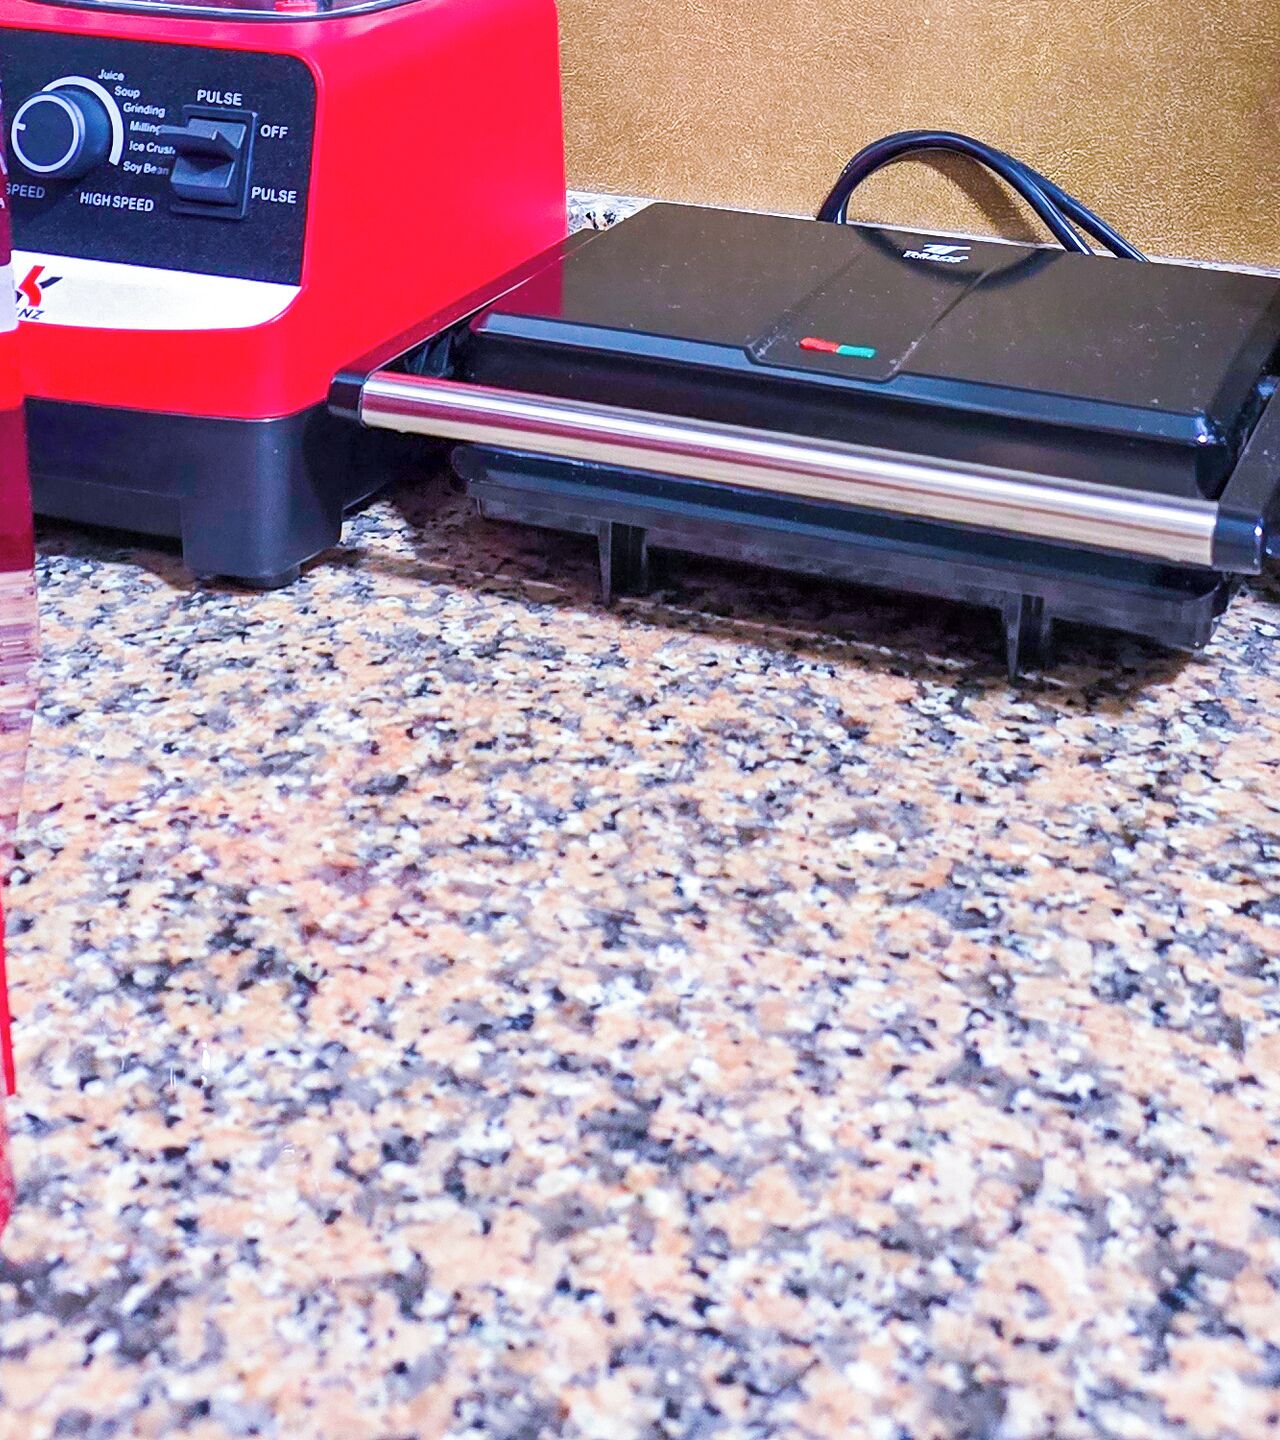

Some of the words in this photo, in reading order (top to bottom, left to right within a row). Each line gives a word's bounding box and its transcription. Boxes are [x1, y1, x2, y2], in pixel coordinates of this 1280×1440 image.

[98, 69, 125, 81] Juice
[114, 85, 141, 99] Soup
[196, 89, 243, 106] PULSE
[123, 102, 166, 118] Grinding
[260, 124, 289, 139] OFF
[128, 140, 145, 152] Ice
[122, 161, 142, 174] Soy
[143, 163, 169, 176] Bean
[79, 192, 111, 207] HIGH
[112, 195, 155, 212] SPEED
[251, 186, 298, 205] PULSE
